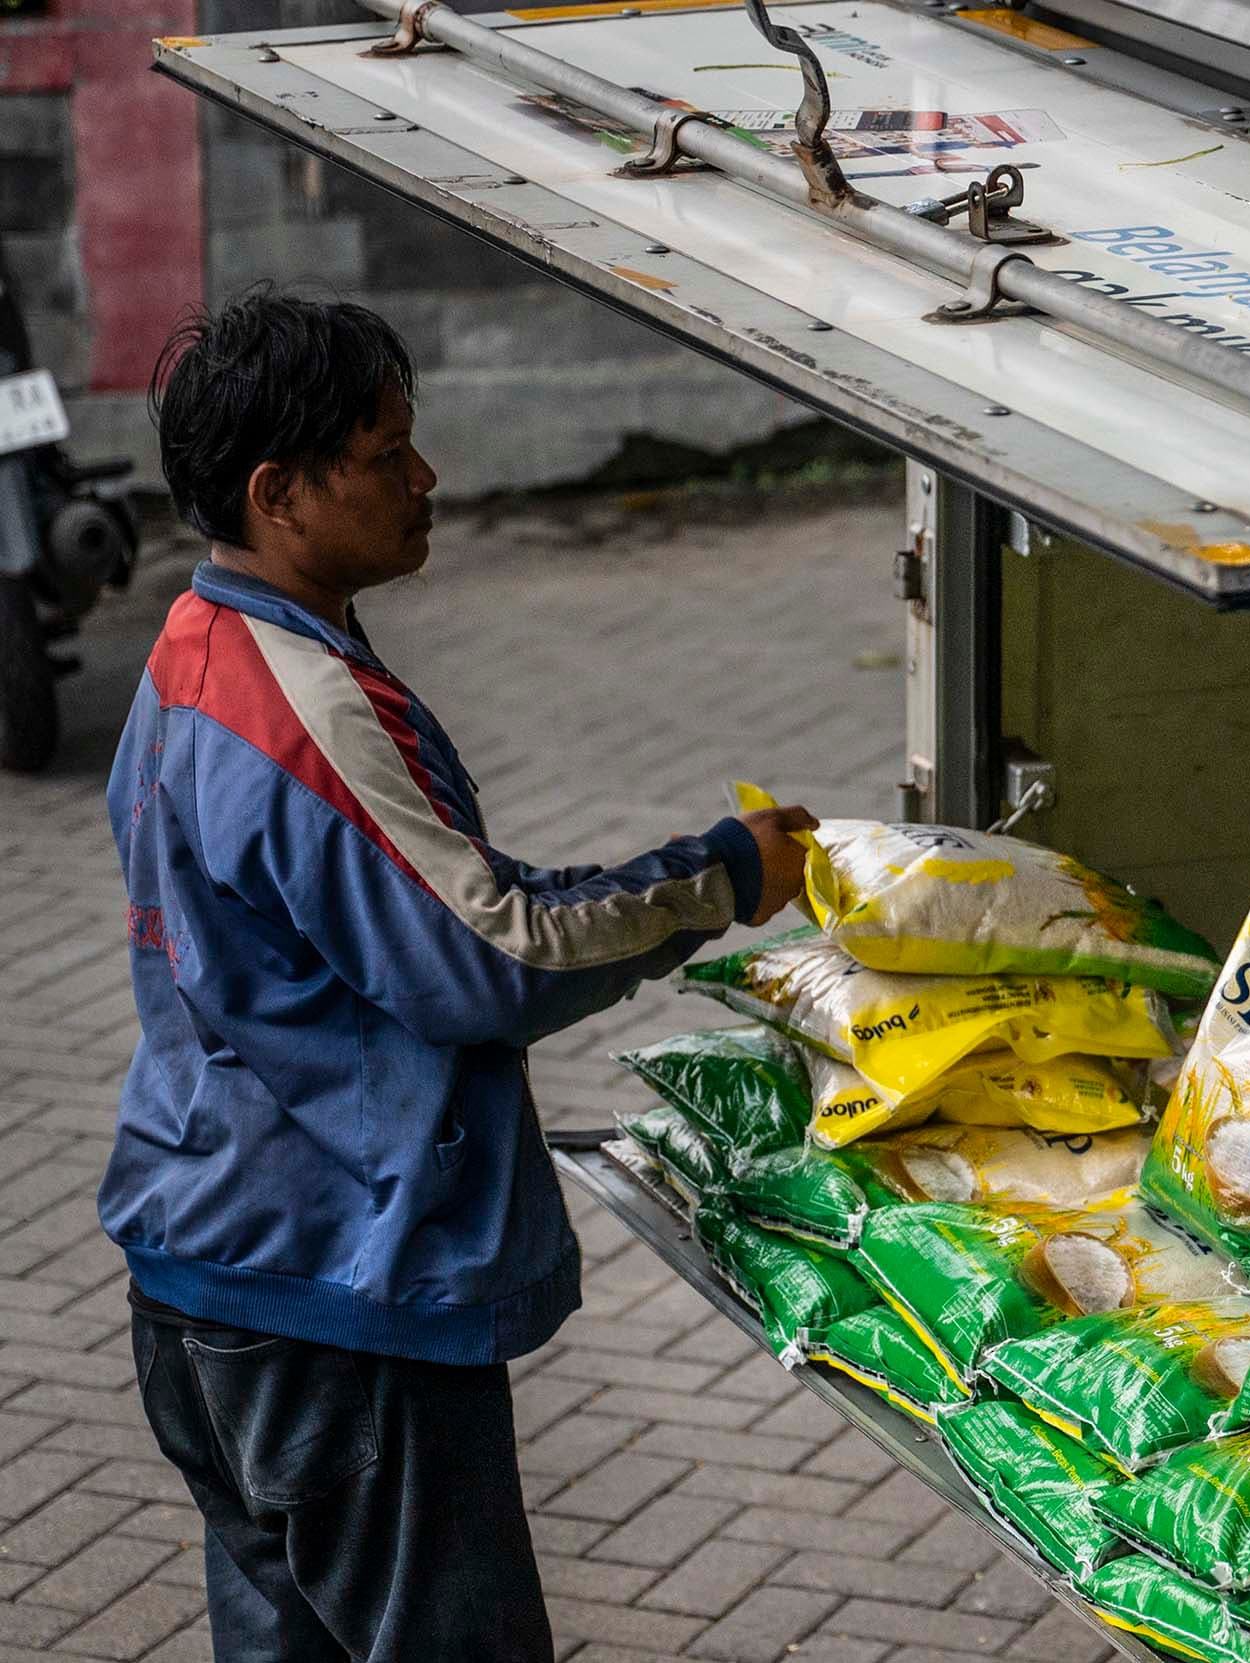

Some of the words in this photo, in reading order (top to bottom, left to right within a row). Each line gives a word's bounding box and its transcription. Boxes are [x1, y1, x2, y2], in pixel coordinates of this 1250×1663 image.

[850, 1013, 907, 1042] bulog
[1172, 1145, 1182, 1174] 5
[1182, 1162, 1195, 1192] kg
